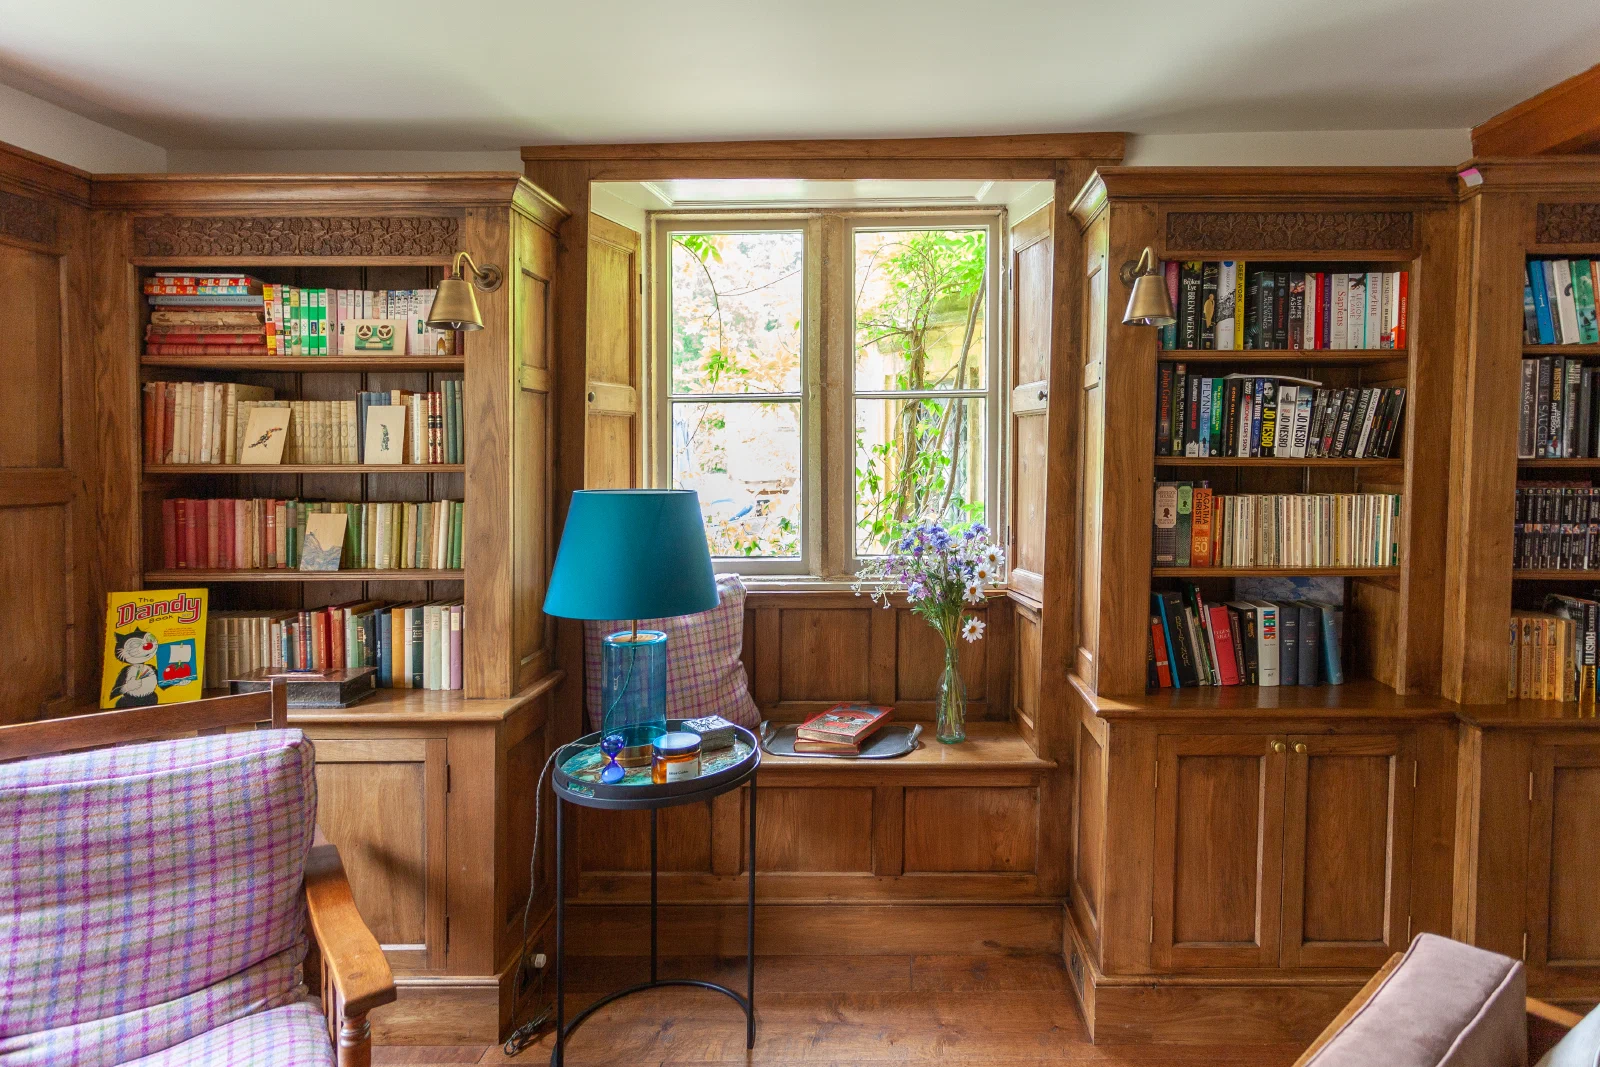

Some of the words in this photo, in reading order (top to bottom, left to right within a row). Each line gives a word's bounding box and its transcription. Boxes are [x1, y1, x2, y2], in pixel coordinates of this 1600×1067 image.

[1371, 276, 1379, 295] HEIR
[1187, 291, 1197, 315] BRENT
[1335, 291, 1346, 327] Sapiens
[1186, 315, 1196, 339] WEEKS
[1162, 369, 1171, 388] John
[1553, 367, 1562, 401] MISTRESS
[1161, 389, 1170, 421] Grisham
[1263, 407, 1276, 419] JO
[1280, 413, 1290, 423] JO
[1296, 413, 1308, 423] JO
[1537, 404, 1549, 446] SAUCER
[1261, 421, 1275, 447] NESBO
[1278, 424, 1289, 448] NESBO
[1294, 424, 1307, 448] NESBO
[1195, 492, 1203, 525] CHRISTIE
[1202, 492, 1210, 525] AGATHA
[1194, 541, 1208, 553] 50
[116, 593, 202, 629] Dandy
[148, 615, 174, 625] Book
[1585, 631, 1596, 665] FORSYTH
[1587, 668, 1595, 689] ICON
